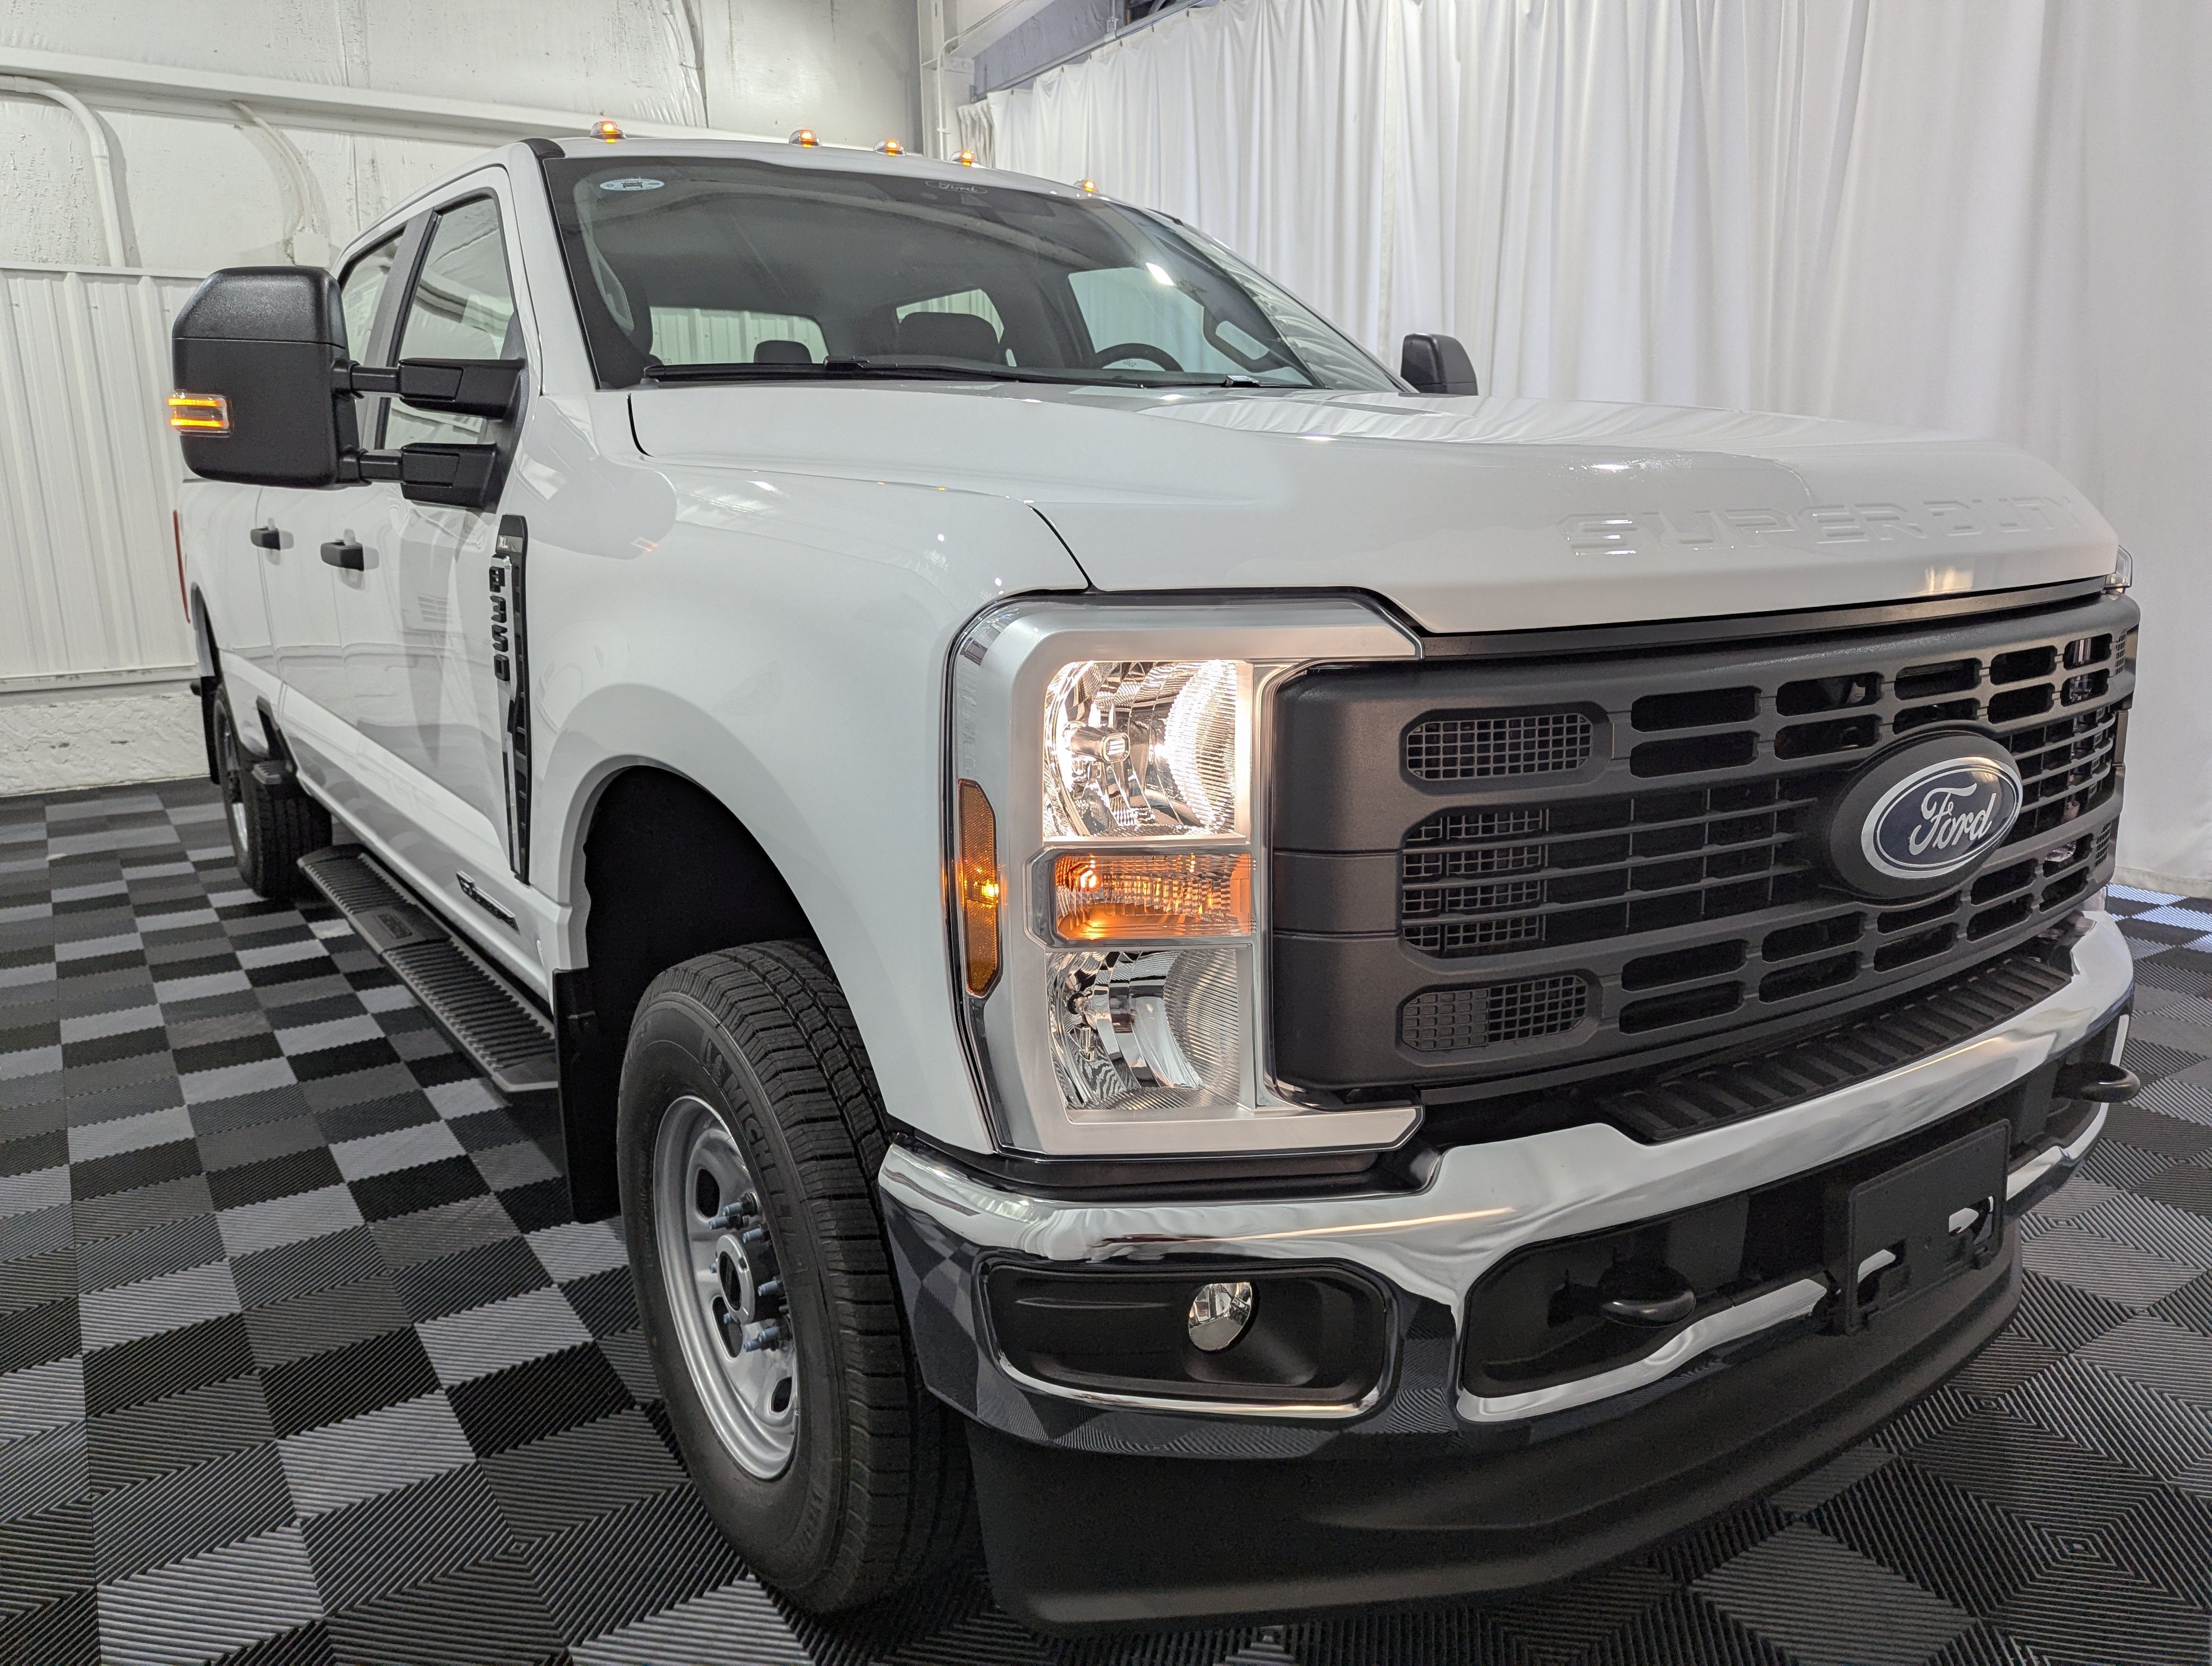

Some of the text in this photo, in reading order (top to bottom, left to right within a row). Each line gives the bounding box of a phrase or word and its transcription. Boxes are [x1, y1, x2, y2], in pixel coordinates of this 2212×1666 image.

[499, 536, 509, 549] XL
[1555, 495, 2082, 556] SUPER DUTY
[1908, 783, 1997, 856] Ford
